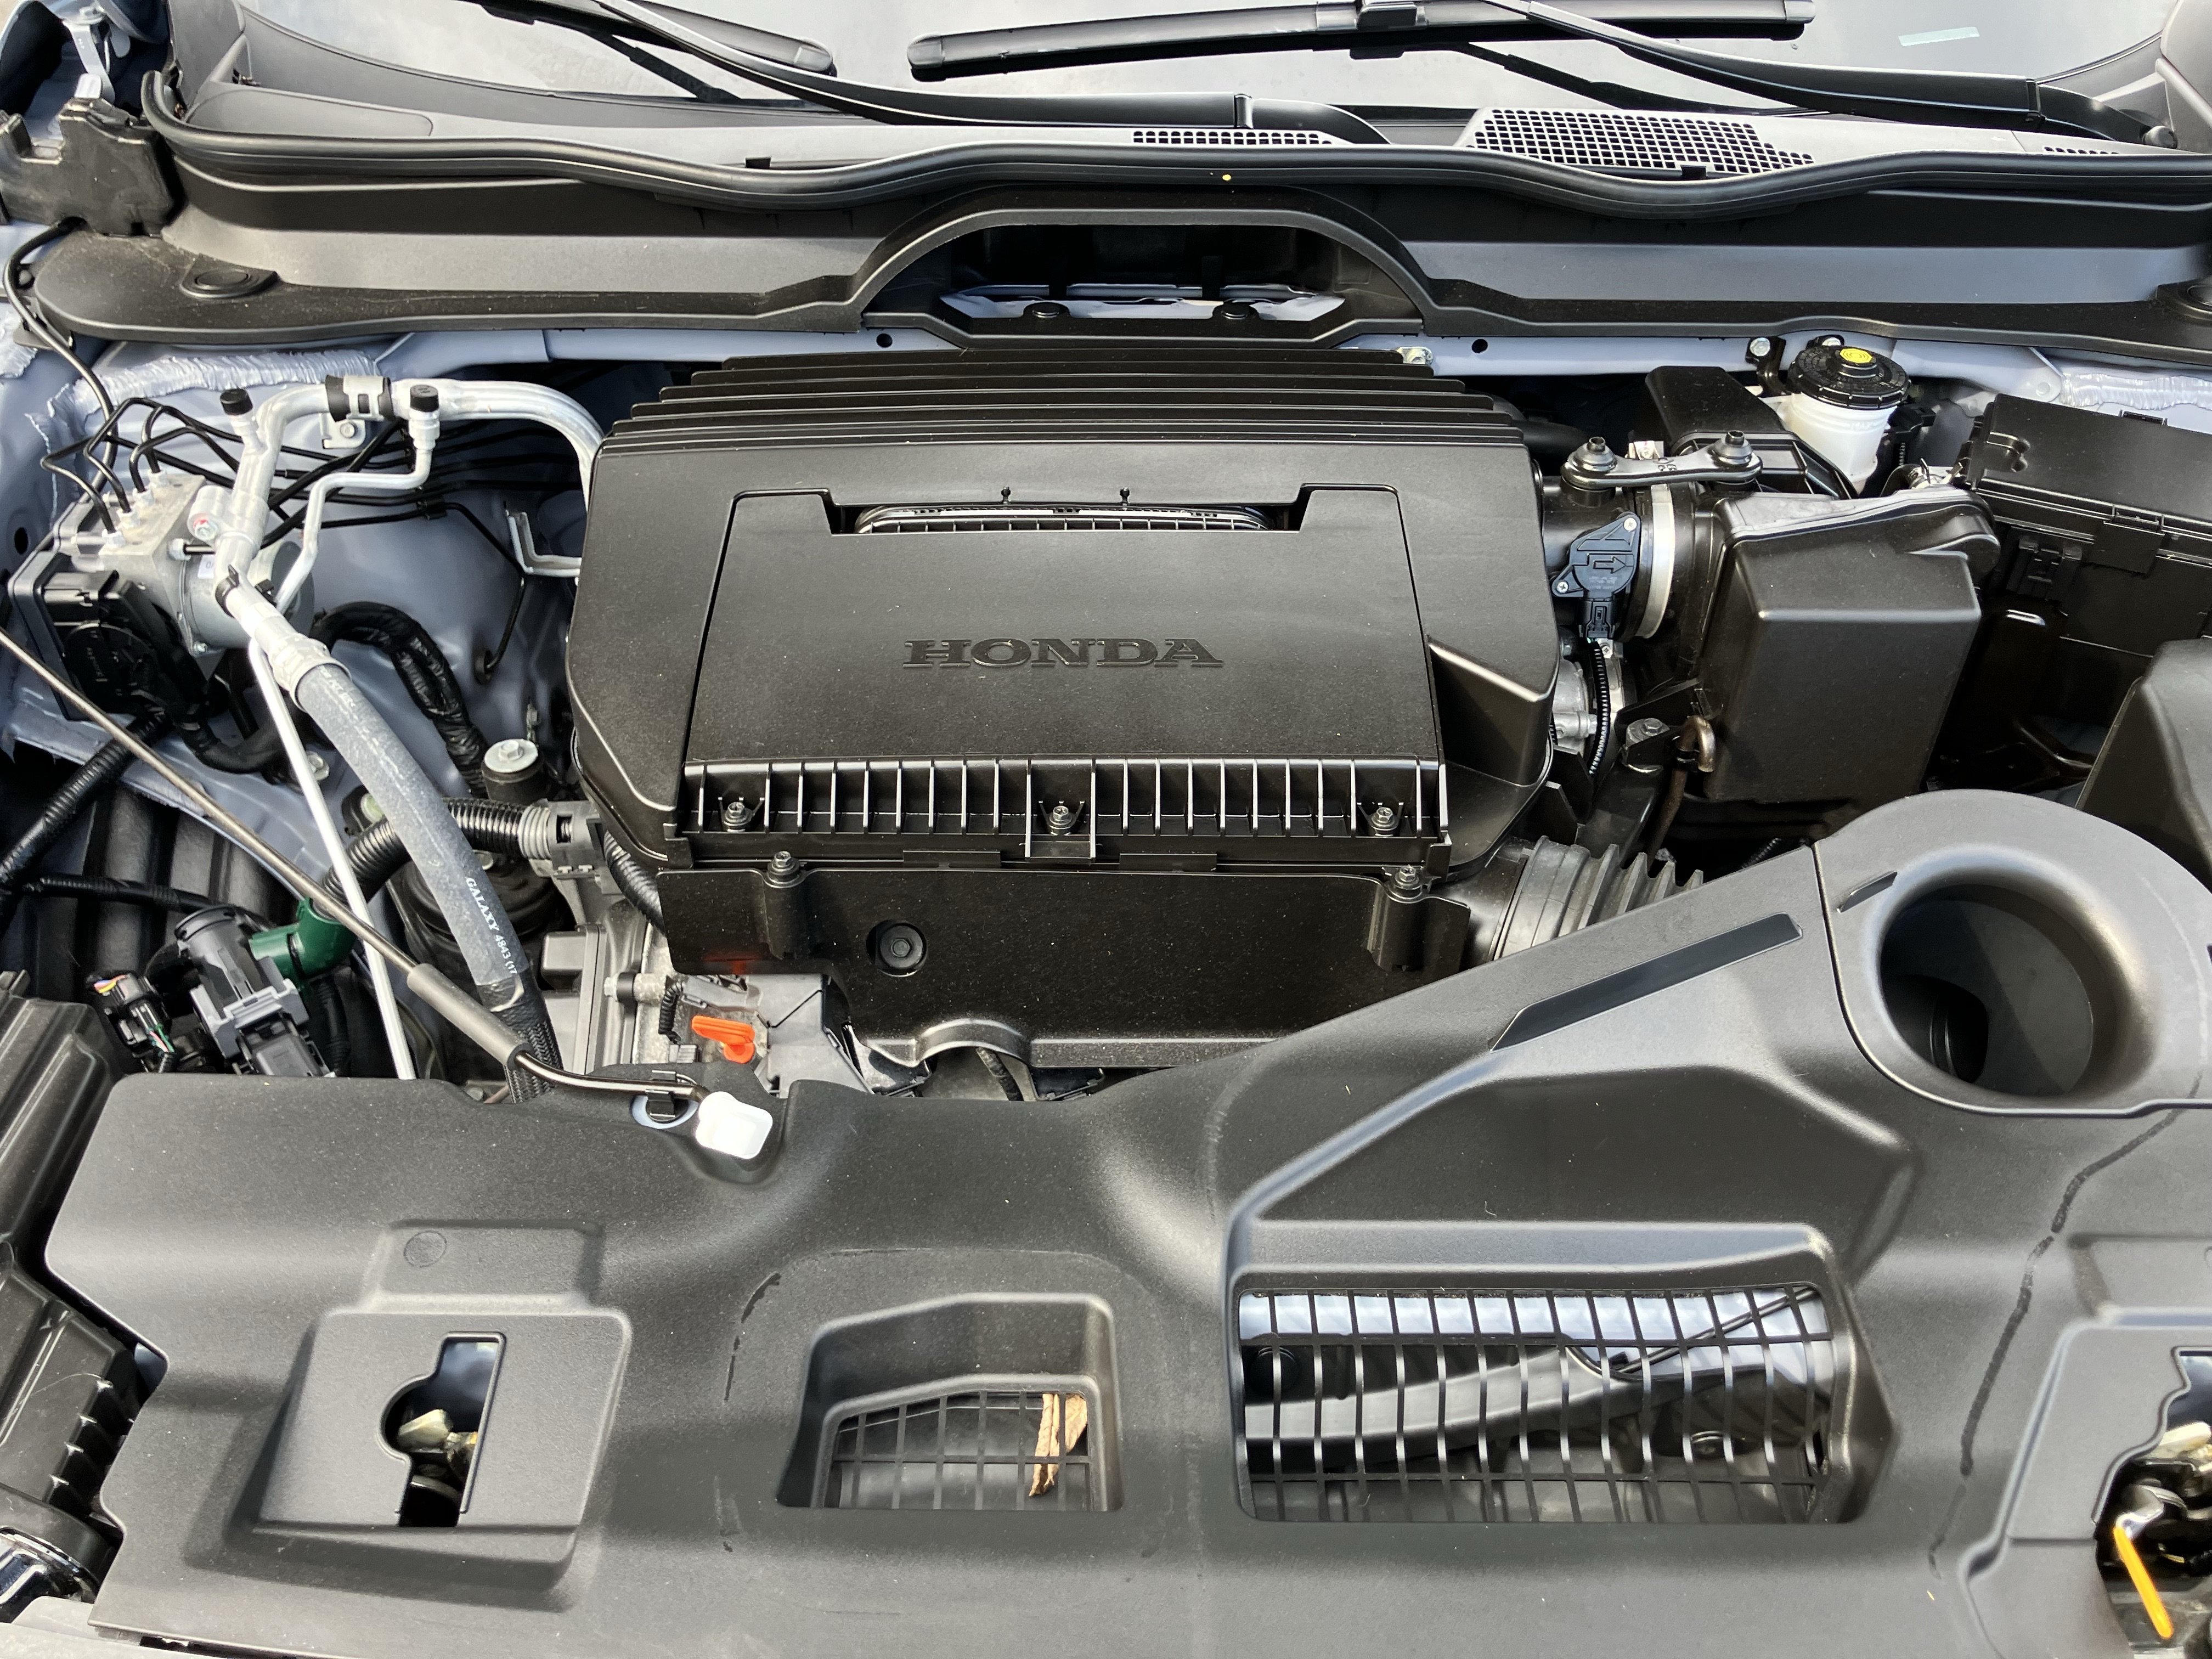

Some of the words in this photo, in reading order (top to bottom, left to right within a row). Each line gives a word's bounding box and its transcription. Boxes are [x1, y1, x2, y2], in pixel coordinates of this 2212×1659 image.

[902, 638, 1223, 668] HONDA
[466, 877, 500, 931] GALAXY
[495, 934, 511, 959] 4843
